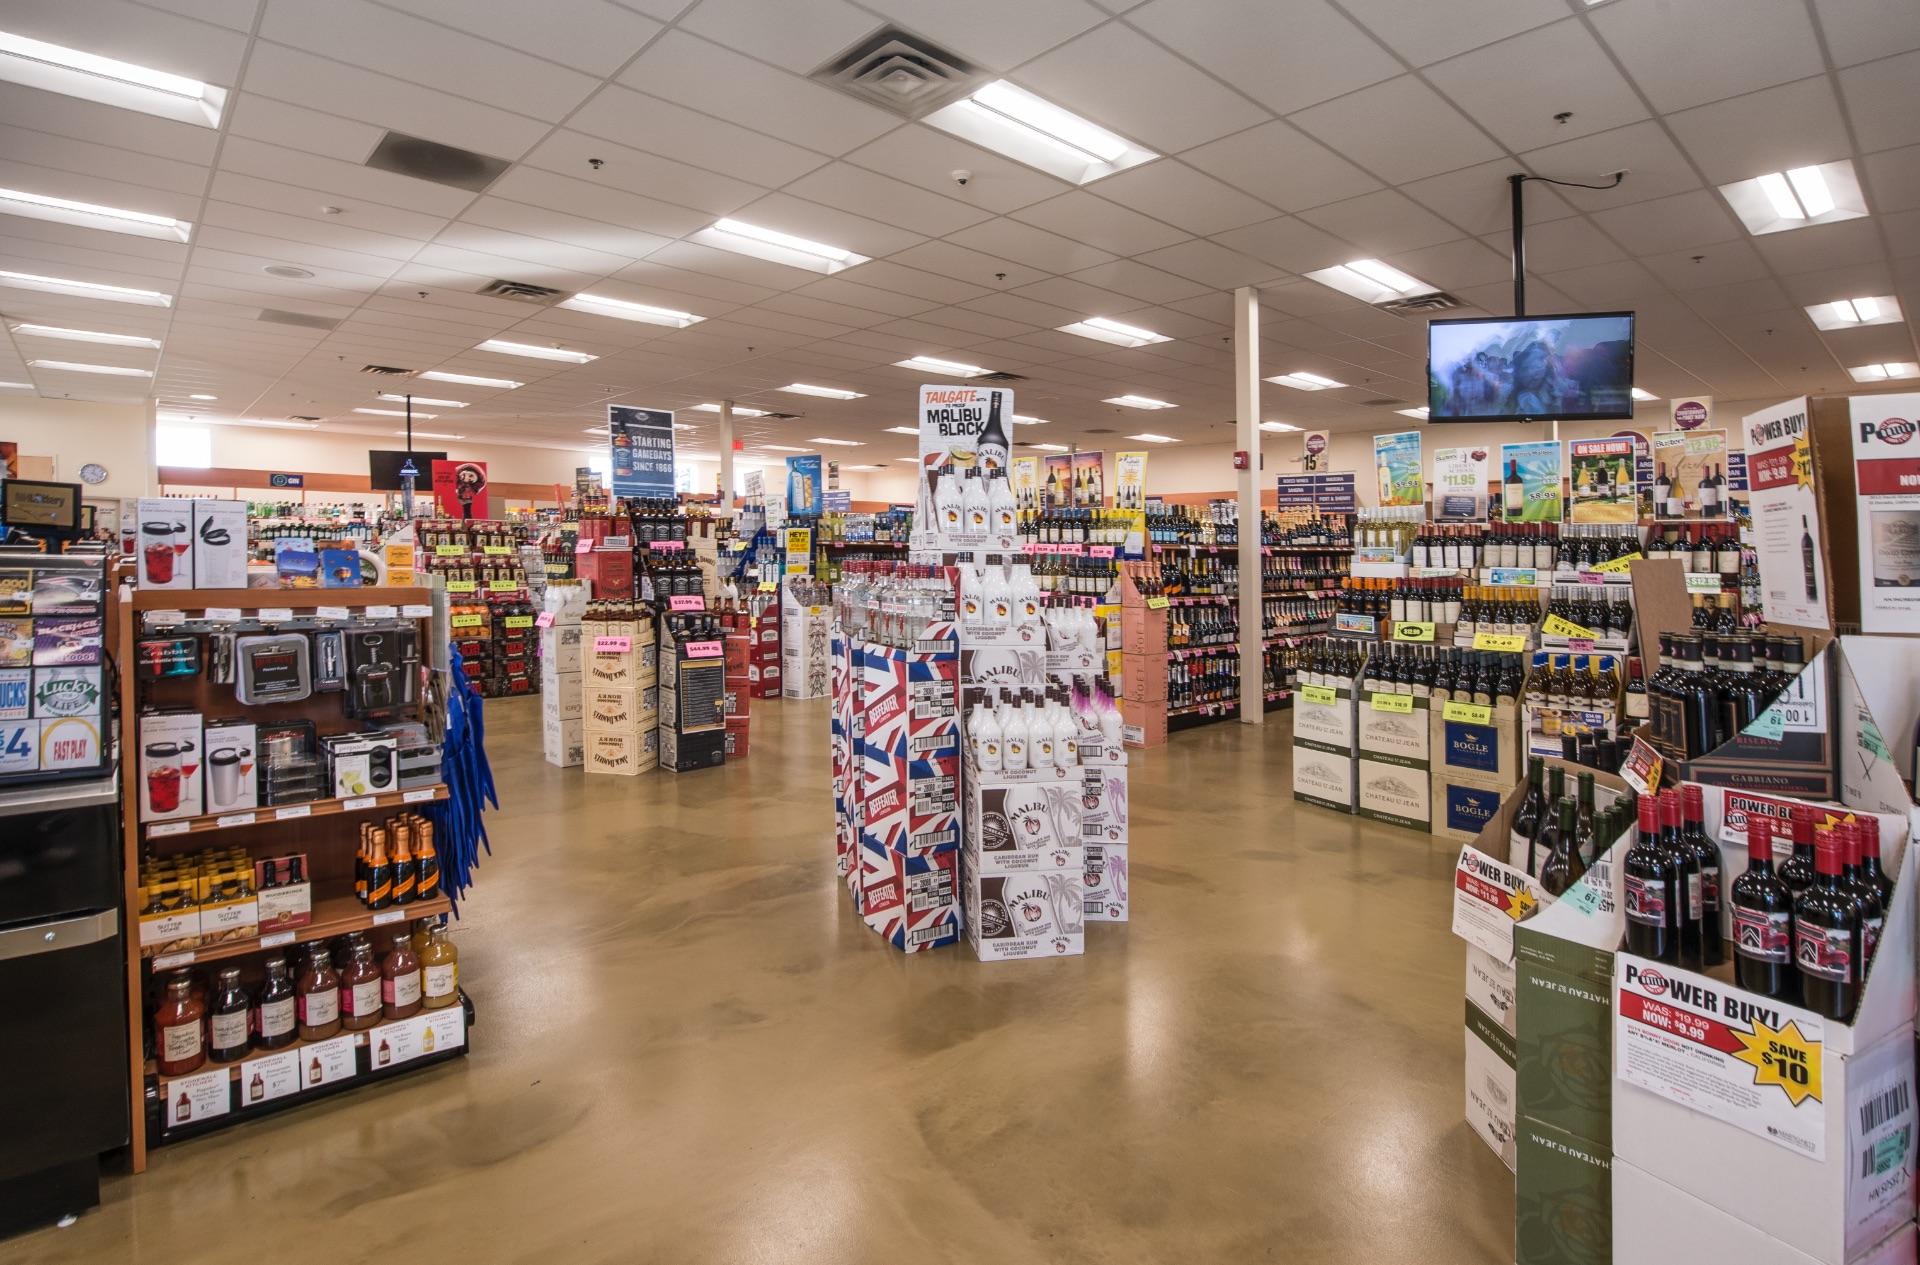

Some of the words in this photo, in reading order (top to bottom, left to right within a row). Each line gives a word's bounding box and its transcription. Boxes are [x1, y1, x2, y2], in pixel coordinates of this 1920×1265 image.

[925, 390, 977, 404] TAILGATE
[927, 408, 982, 424] MALIBU
[939, 422, 985, 436] BLACK
[1750, 420, 1783, 446] POWER
[632, 436, 672, 449] STARTING
[1589, 443, 1604, 453] SALE
[632, 448, 672, 460] GAMEDAYS
[1304, 454, 1316, 470] 15
[632, 461, 654, 471] SINCE
[1443, 474, 1476, 486] $11.95
[976, 665, 1020, 682] MALIBU
[43, 679, 95, 696] Lucky
[52, 700, 82, 712] LIFE
[868, 694, 900, 727] BEEFEATER
[614, 712, 627, 722] JACK
[5, 728, 32, 758] 4
[53, 740, 70, 761] FAST
[71, 739, 88, 760] PLAY
[1402, 739, 1420, 747] JEAN
[1453, 740, 1488, 753] BOGLE
[615, 755, 628, 765] JACK
[1731, 774, 1789, 784] GABBIANO
[868, 789, 899, 818] BEEFEATER
[1011, 802, 1049, 822] MALIBU
[1403, 800, 1420, 808] JEAN
[1456, 804, 1491, 817] BOGLE
[1731, 797, 1776, 816] POWER
[1461, 852, 1501, 883] POWER
[1504, 871, 1525, 891] BUY!
[868, 884, 897, 909] BEEFEATER
[1009, 889, 1050, 910] MALIBU
[1568, 988, 1610, 1006] HATEAU
[1626, 964, 1718, 1013] POWER
[1724, 996, 1779, 1028] BUY!
[1642, 999, 1672, 1018] WAS:
[1675, 1011, 1710, 1030] $19.99
[1642, 1011, 1672, 1029] NOW:
[1674, 1020, 1705, 1041] $9.99
[1768, 1040, 1807, 1064] SAVE
[1761, 1052, 1809, 1085] $10
[1568, 1148, 1610, 1169] HATEAU
